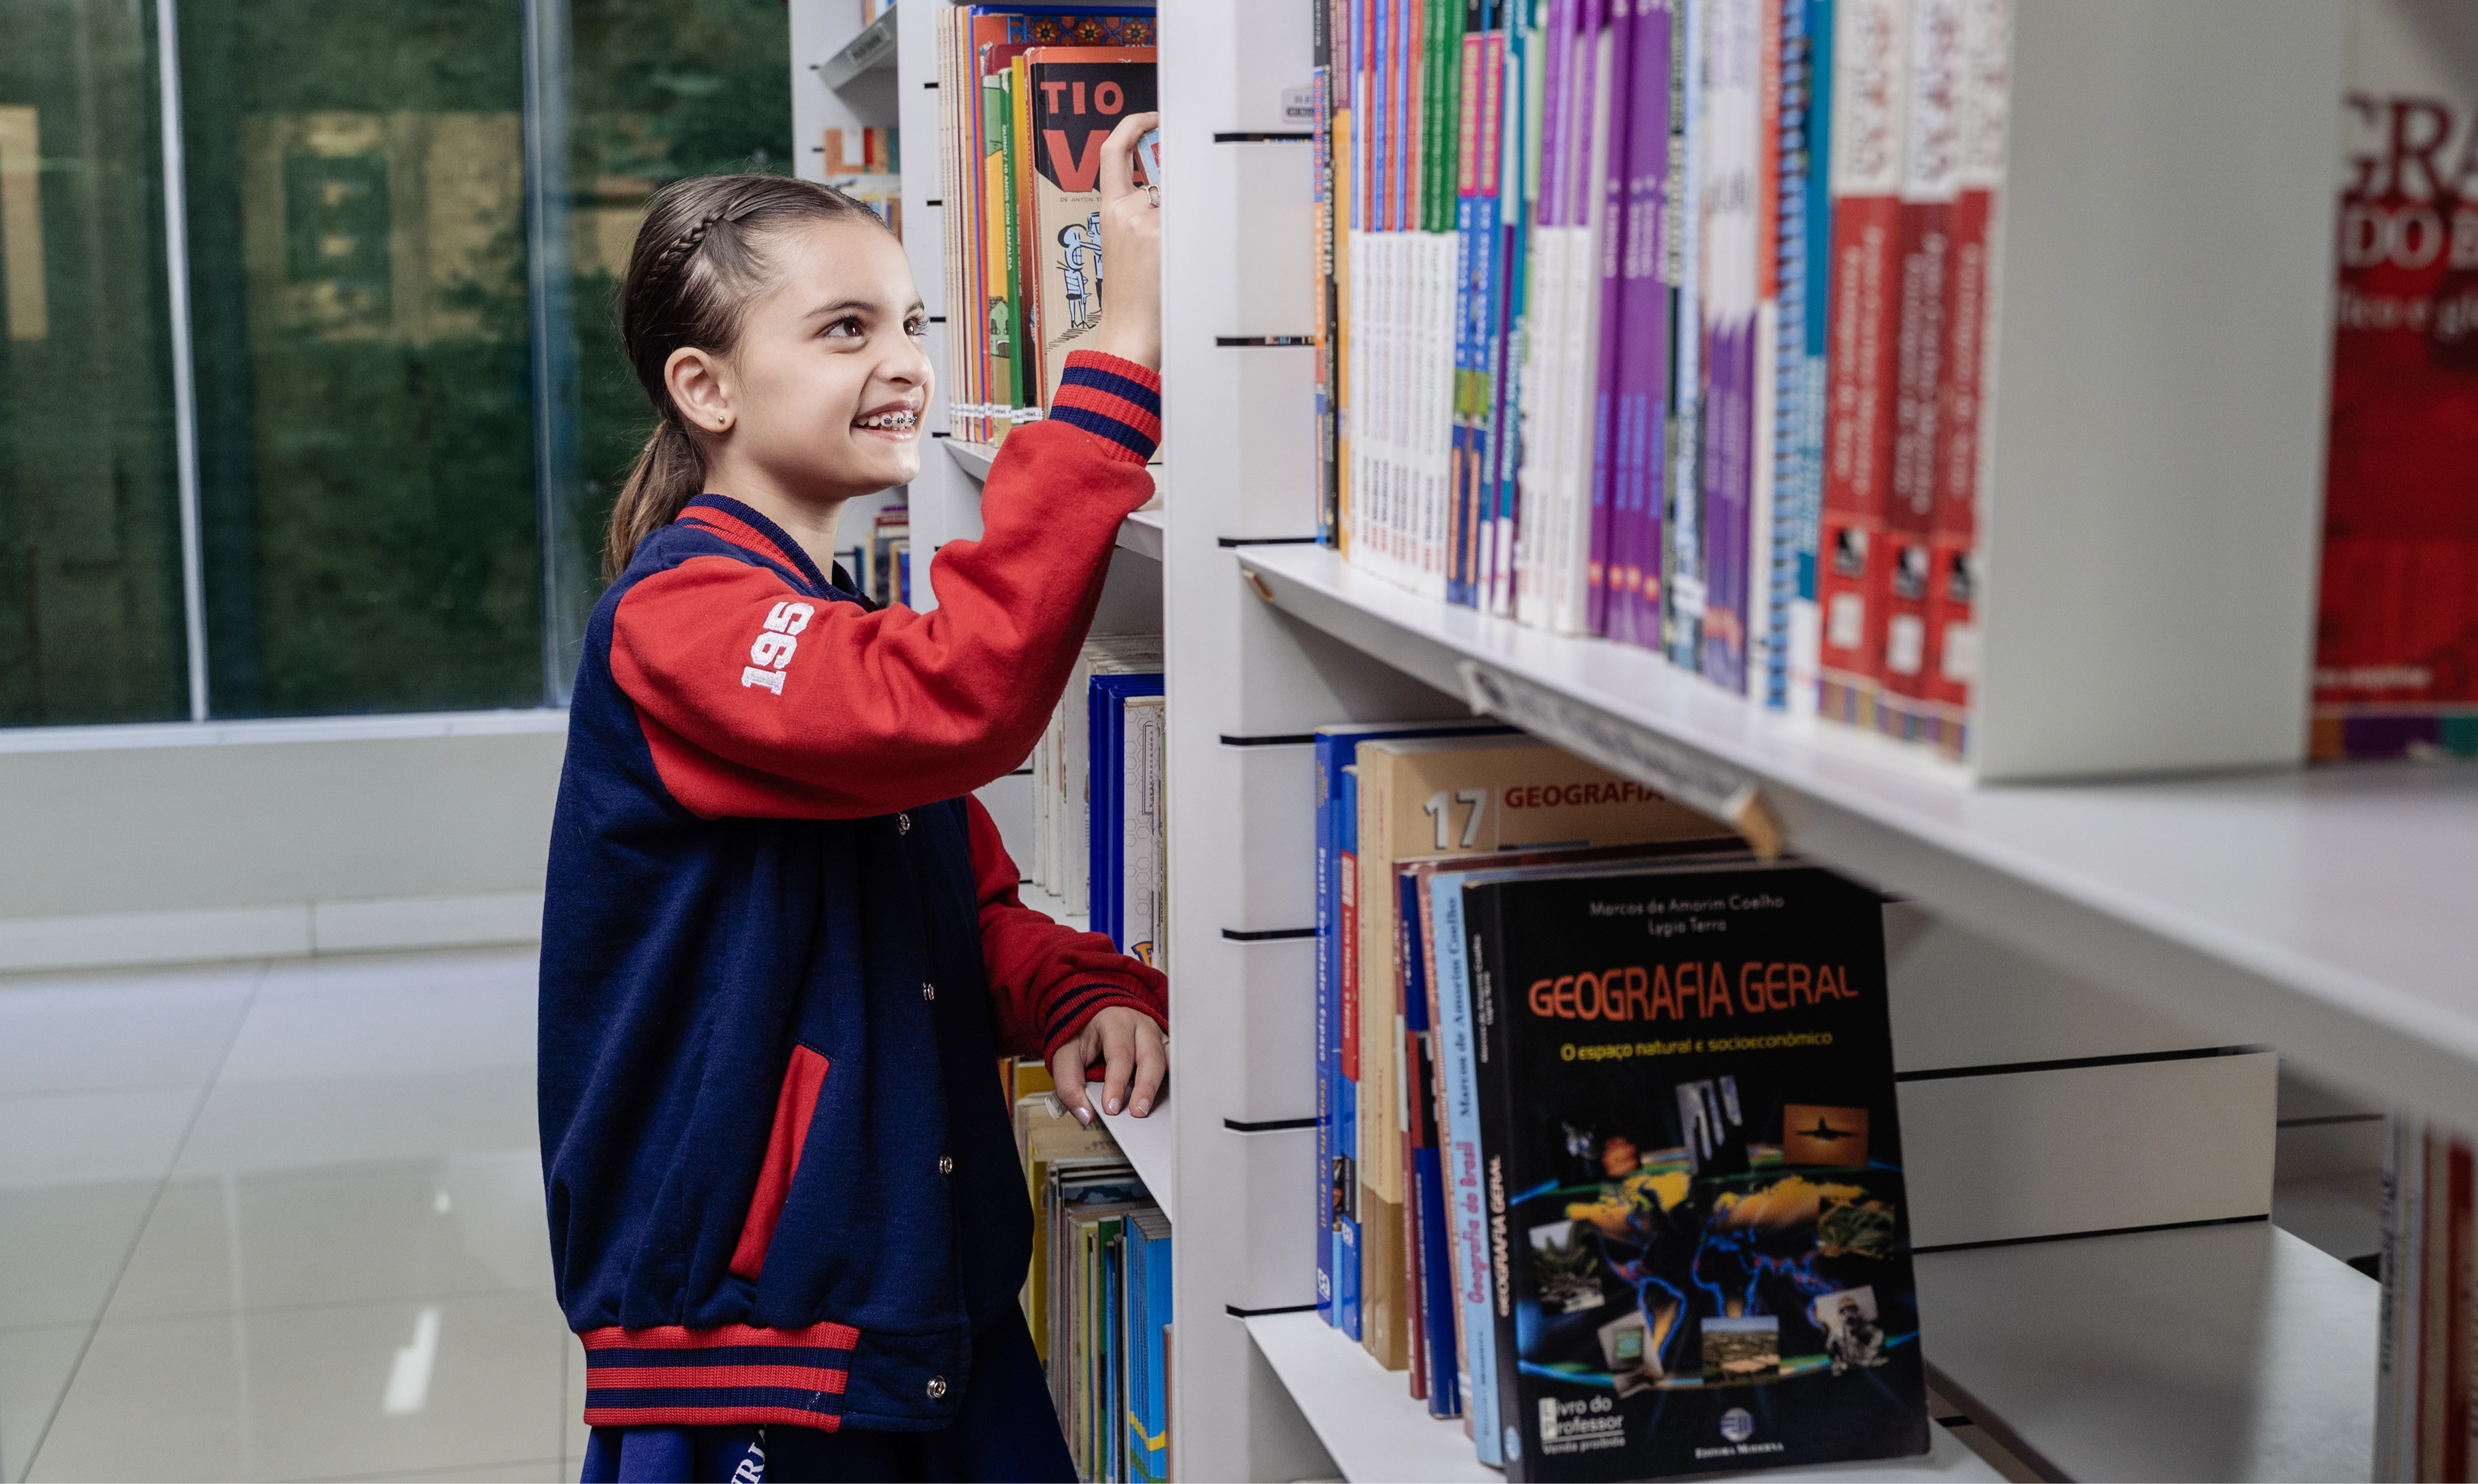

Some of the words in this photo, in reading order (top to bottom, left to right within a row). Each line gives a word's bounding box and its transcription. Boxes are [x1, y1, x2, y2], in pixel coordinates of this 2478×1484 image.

[1040, 81, 1124, 115] TIO
[1004, 163, 1009, 174] 10
[1042, 129, 1110, 193] V
[741, 601, 815, 696] 195
[1423, 788, 1488, 851] 17
[1504, 782, 1665, 809] GEOGRAFIA
[1445, 896, 1461, 956] Coelho
[1589, 900, 1644, 916] Marcos
[1646, 898, 1665, 914] de
[1668, 898, 1726, 913] Amorim
[1728, 893, 1785, 910] Coelho
[1647, 919, 1686, 937] Lygia
[1689, 916, 1727, 933] Terra
[1450, 959, 1465, 1027] Amorim
[1528, 961, 1734, 1021] GEOGRAFIA
[1740, 962, 1859, 1013] GERAL
[1453, 1032, 1467, 1052] de
[1561, 1043, 1576, 1061] O
[1577, 1043, 1634, 1062] espaço
[1635, 1037, 1692, 1056] natural
[1695, 1039, 1705, 1053] e
[1707, 1031, 1834, 1052] socioeconômico
[1457, 1057, 1471, 1118] Marcos
[1456, 1140, 1477, 1187] Brasil
[1489, 1153, 1506, 1214] GERAL
[1458, 1192, 1479, 1214] do
[1464, 1219, 1489, 1304] Geografia
[1491, 1214, 1510, 1317] GEOGRAFIA
[1589, 1393, 1613, 1413] do
